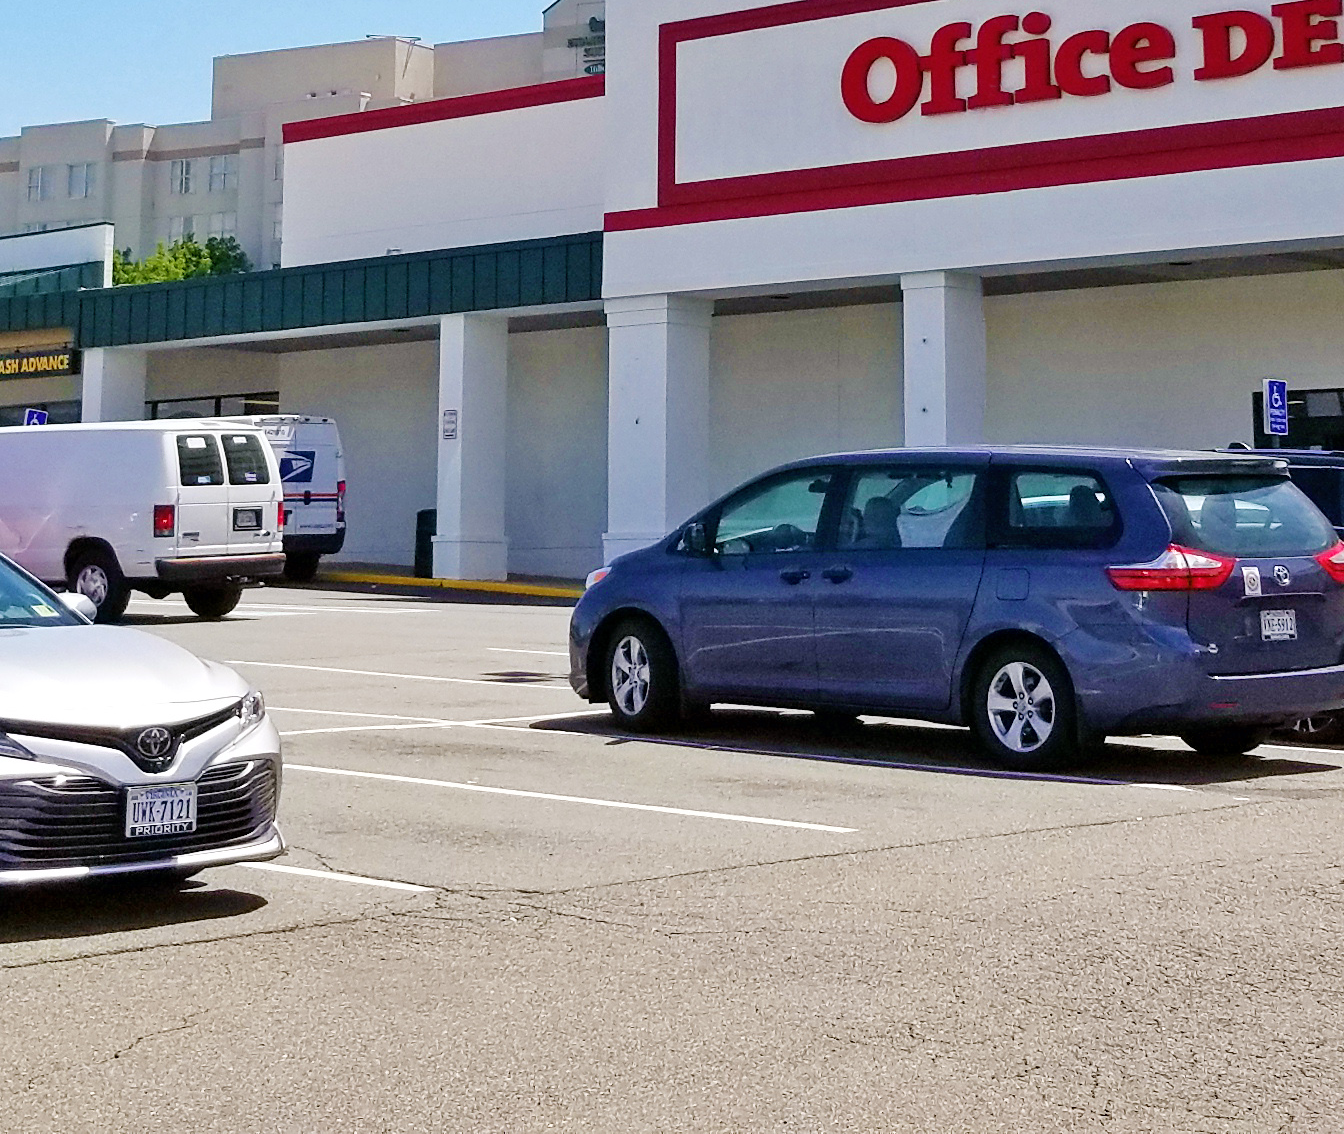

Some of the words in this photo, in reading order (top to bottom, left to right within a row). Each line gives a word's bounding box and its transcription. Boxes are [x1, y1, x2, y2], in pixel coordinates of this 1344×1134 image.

[840, 11, 1176, 123] Office
[21, 354, 69, 373] ADVANCE
[132, 798, 191, 823] UWK-7121
[136, 823, 189, 836] PRIORITY
